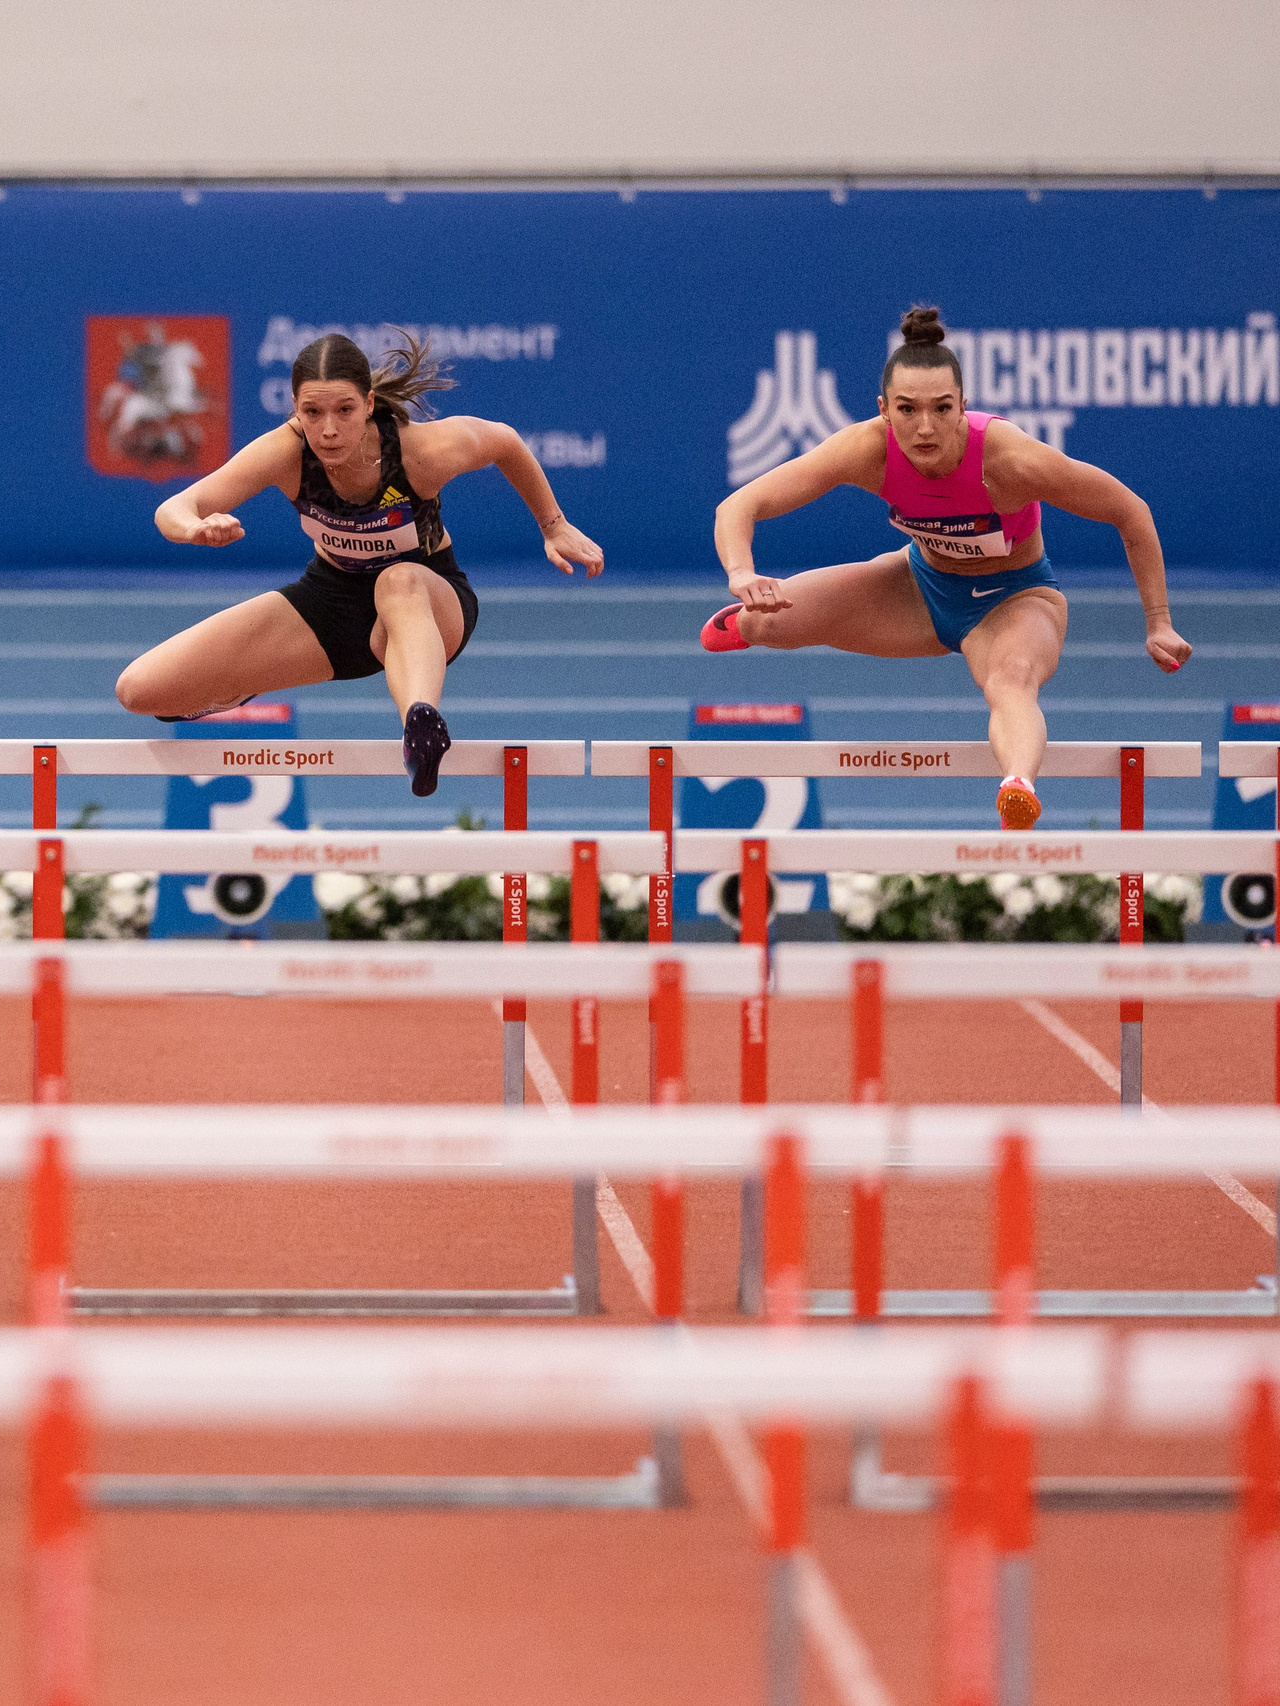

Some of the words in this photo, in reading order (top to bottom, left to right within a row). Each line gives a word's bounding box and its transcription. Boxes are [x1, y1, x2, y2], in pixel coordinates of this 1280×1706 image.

[309, 507, 355, 527] Русская
[321, 532, 396, 552] ОСИПОВА
[284, 750, 334, 769] Sport
[900, 752, 951, 771] Sport
[508, 888, 523, 927] Sport
[653, 889, 669, 928] Sport
[1124, 889, 1140, 928] Sport
